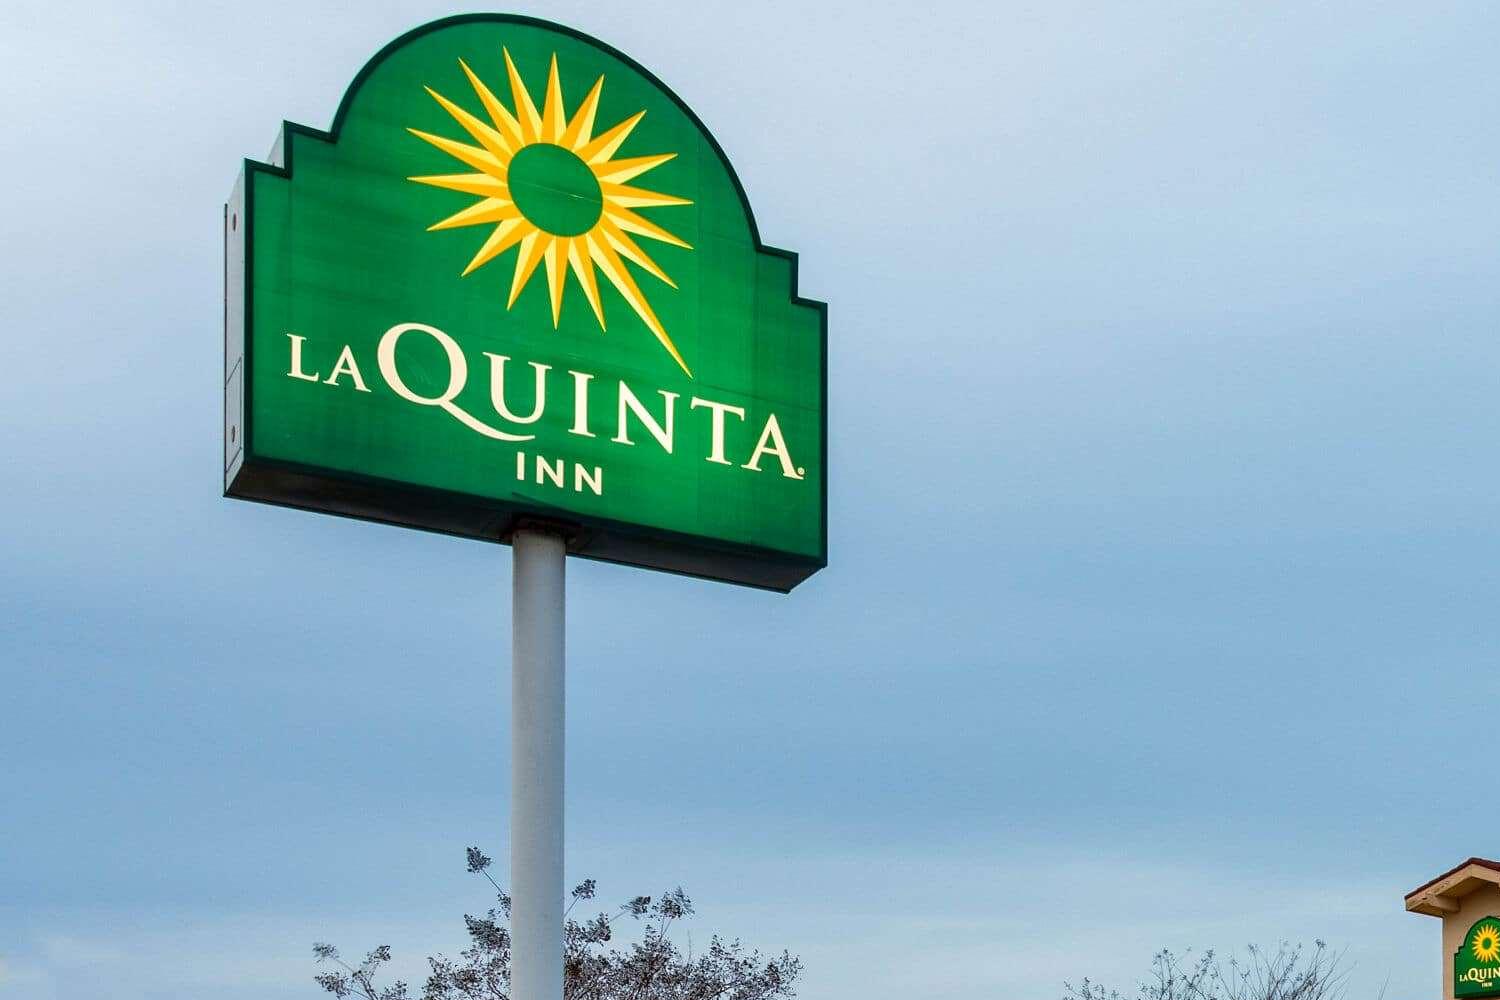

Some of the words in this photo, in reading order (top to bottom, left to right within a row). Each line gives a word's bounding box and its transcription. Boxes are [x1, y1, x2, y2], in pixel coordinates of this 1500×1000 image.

[286, 333, 372, 393] LA
[377, 322, 804, 480] QUINTA
[516, 451, 603, 496] INN
